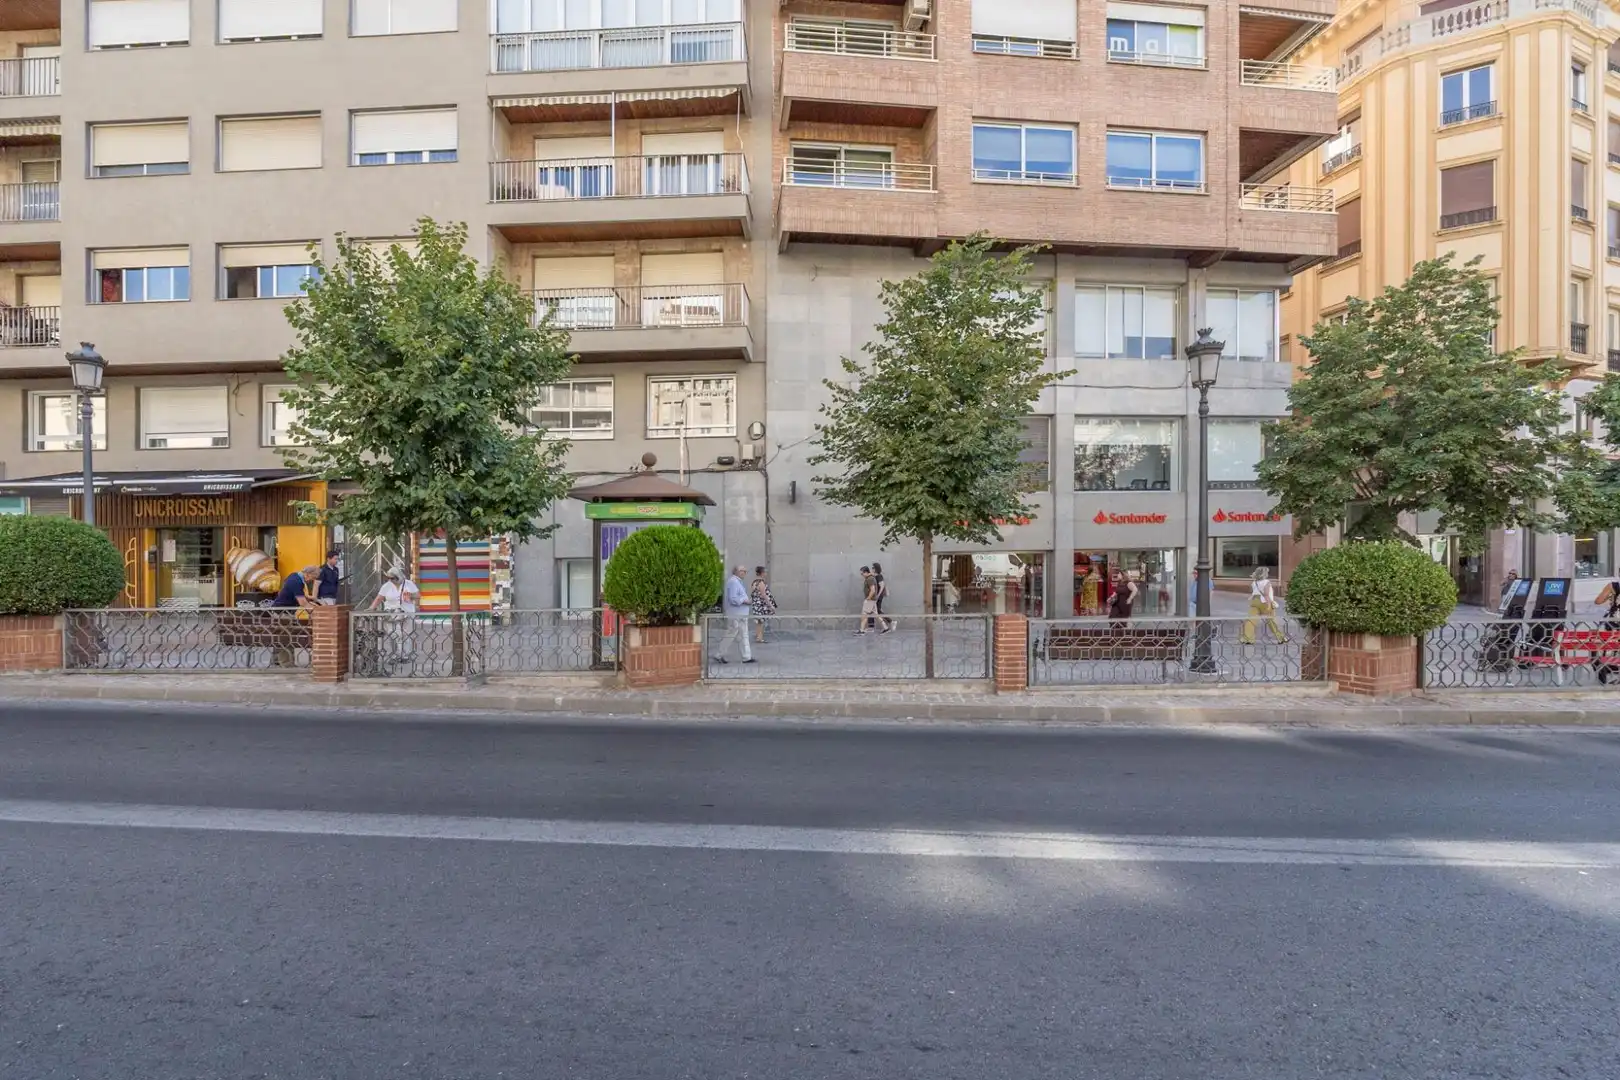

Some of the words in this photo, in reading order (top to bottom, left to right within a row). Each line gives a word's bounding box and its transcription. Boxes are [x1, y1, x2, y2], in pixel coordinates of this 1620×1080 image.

[135, 498, 233, 517] UNICROISSANT
[1109, 512, 1167, 524] Santander
[1228, 511, 1283, 522] Santaner
